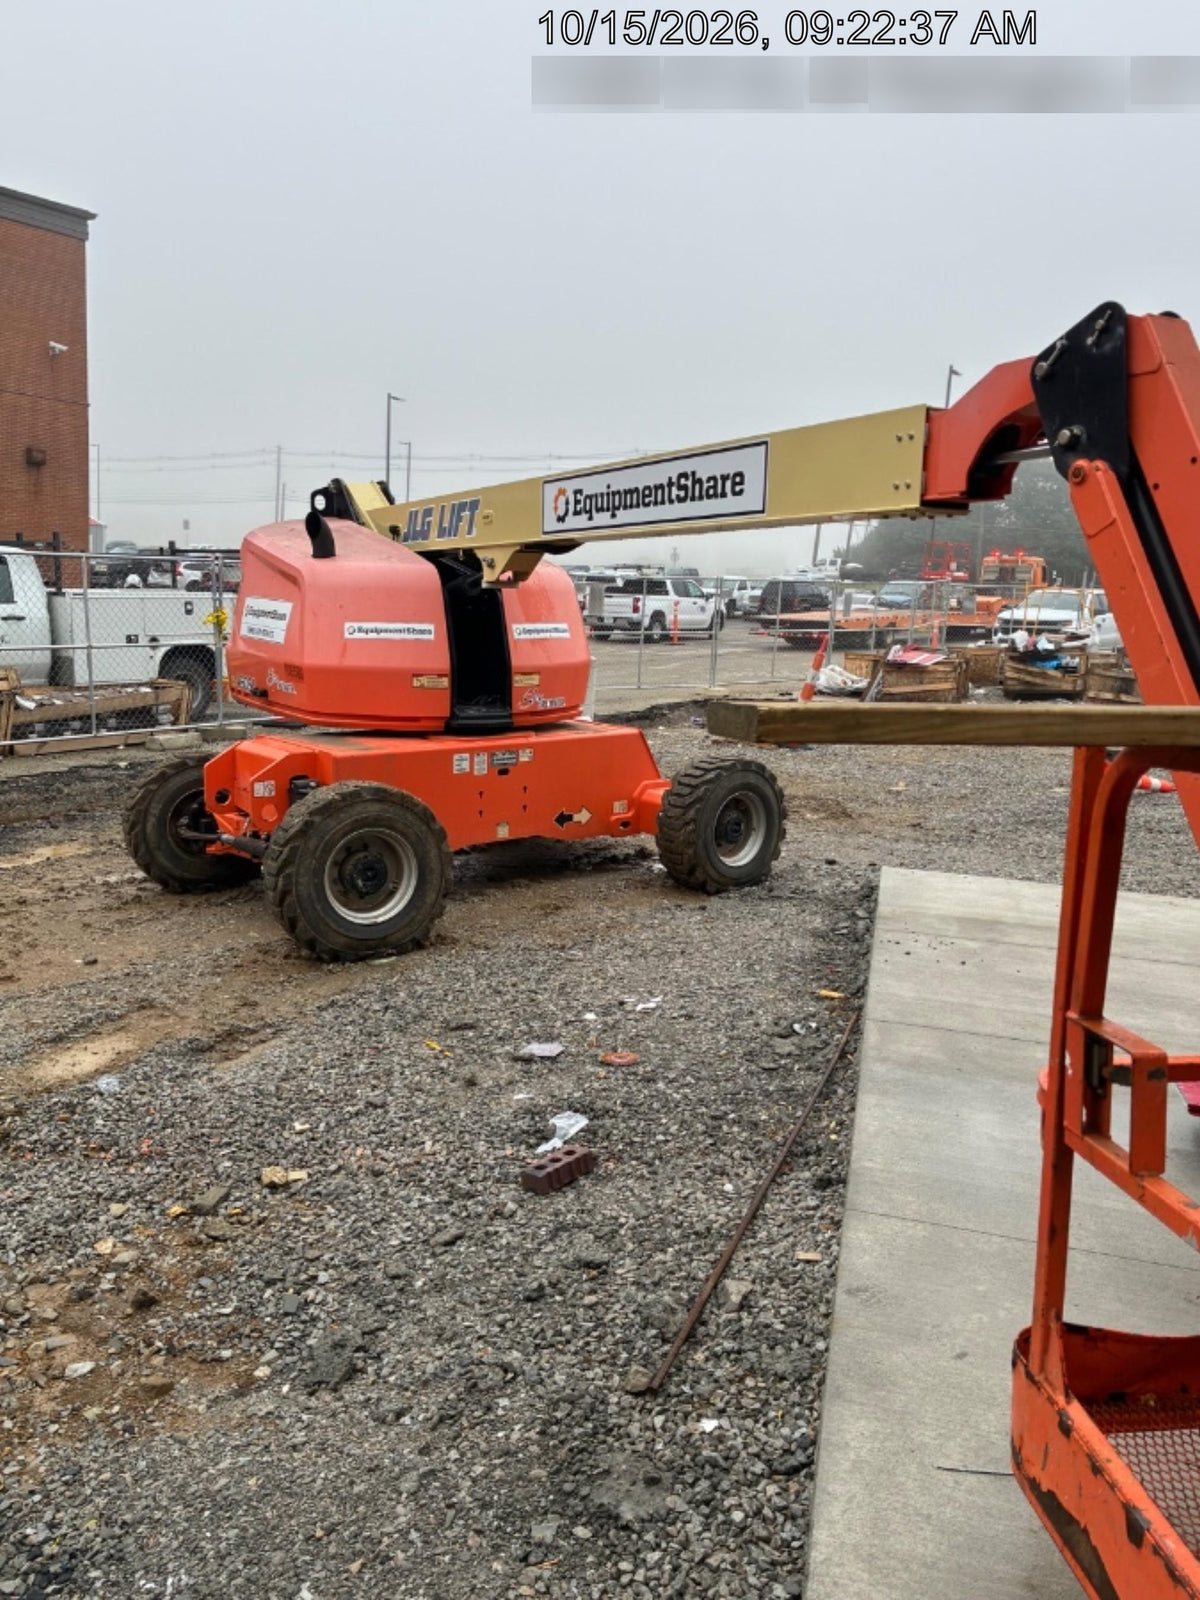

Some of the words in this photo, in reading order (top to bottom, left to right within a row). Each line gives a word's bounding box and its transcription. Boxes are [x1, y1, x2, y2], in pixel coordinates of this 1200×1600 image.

[401, 505, 435, 545] JLG
[436, 497, 481, 541] LIFT
[571, 470, 746, 522] EquipmentShare
